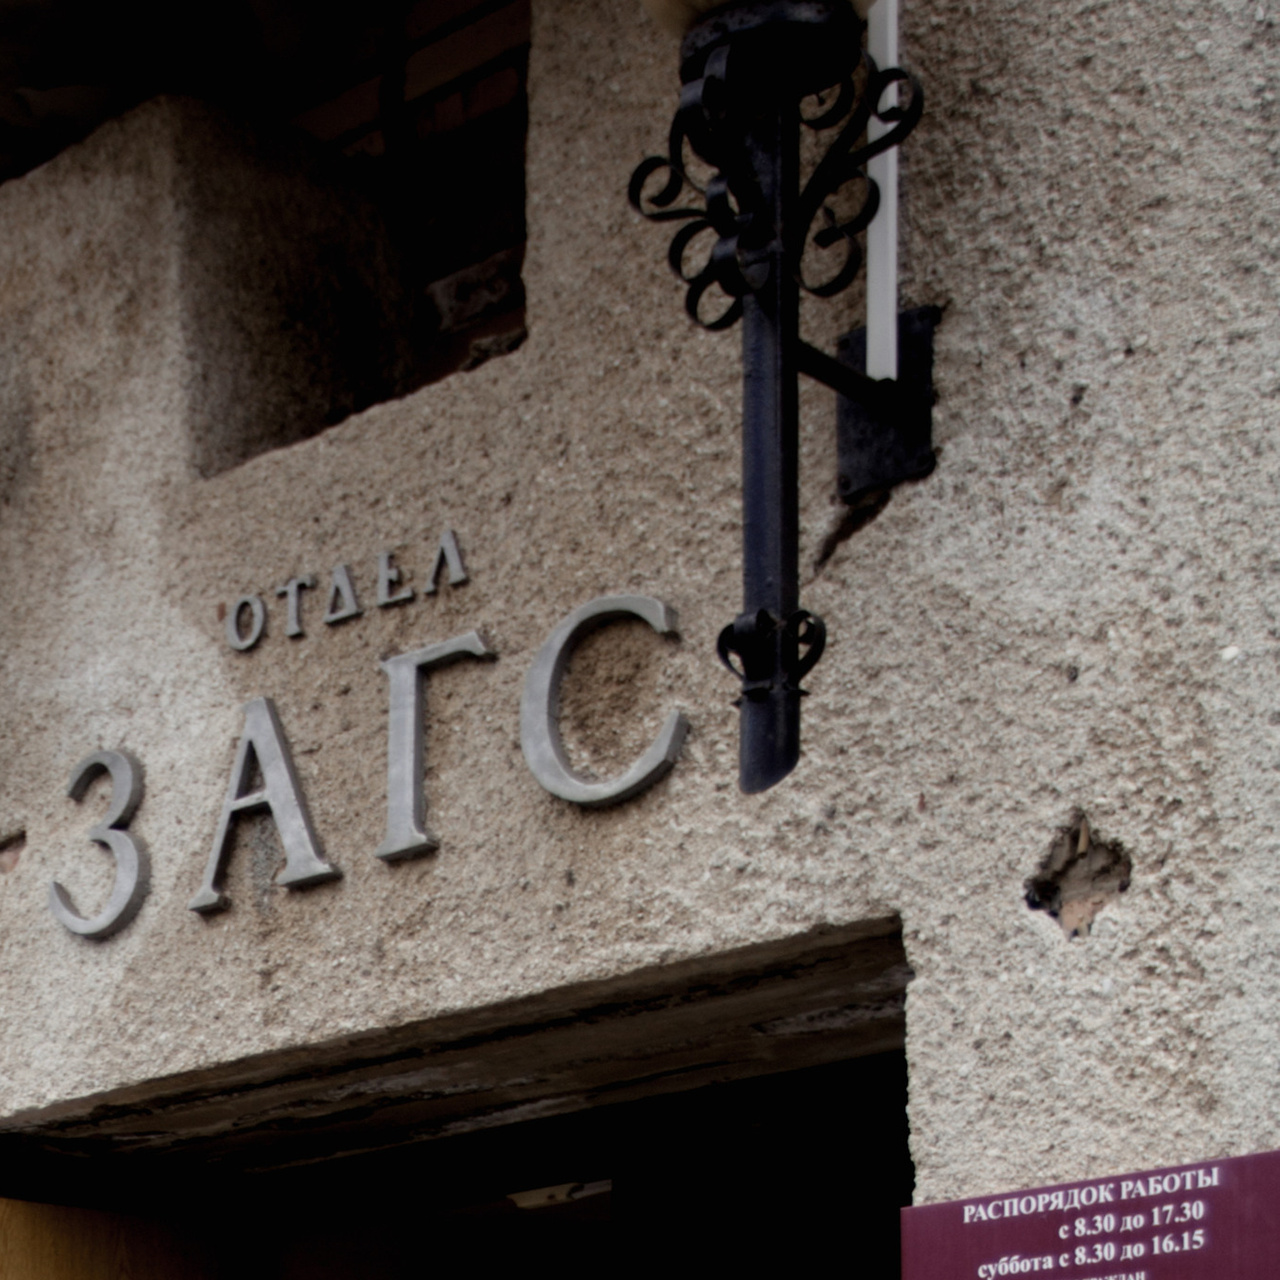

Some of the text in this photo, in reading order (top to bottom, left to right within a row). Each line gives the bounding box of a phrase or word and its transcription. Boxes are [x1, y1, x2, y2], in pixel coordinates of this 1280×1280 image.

[226, 529, 469, 651] ОТДЕЛ
[48, 593, 690, 939] ЗАГС
[963, 1167, 1220, 1223] РАСПОРЯДОК РАБОТЫ
[1059, 1201, 1204, 1239] с 8.30 до 17.30
[978, 1229, 1204, 1280] суббота с 8.30 до 16.15
